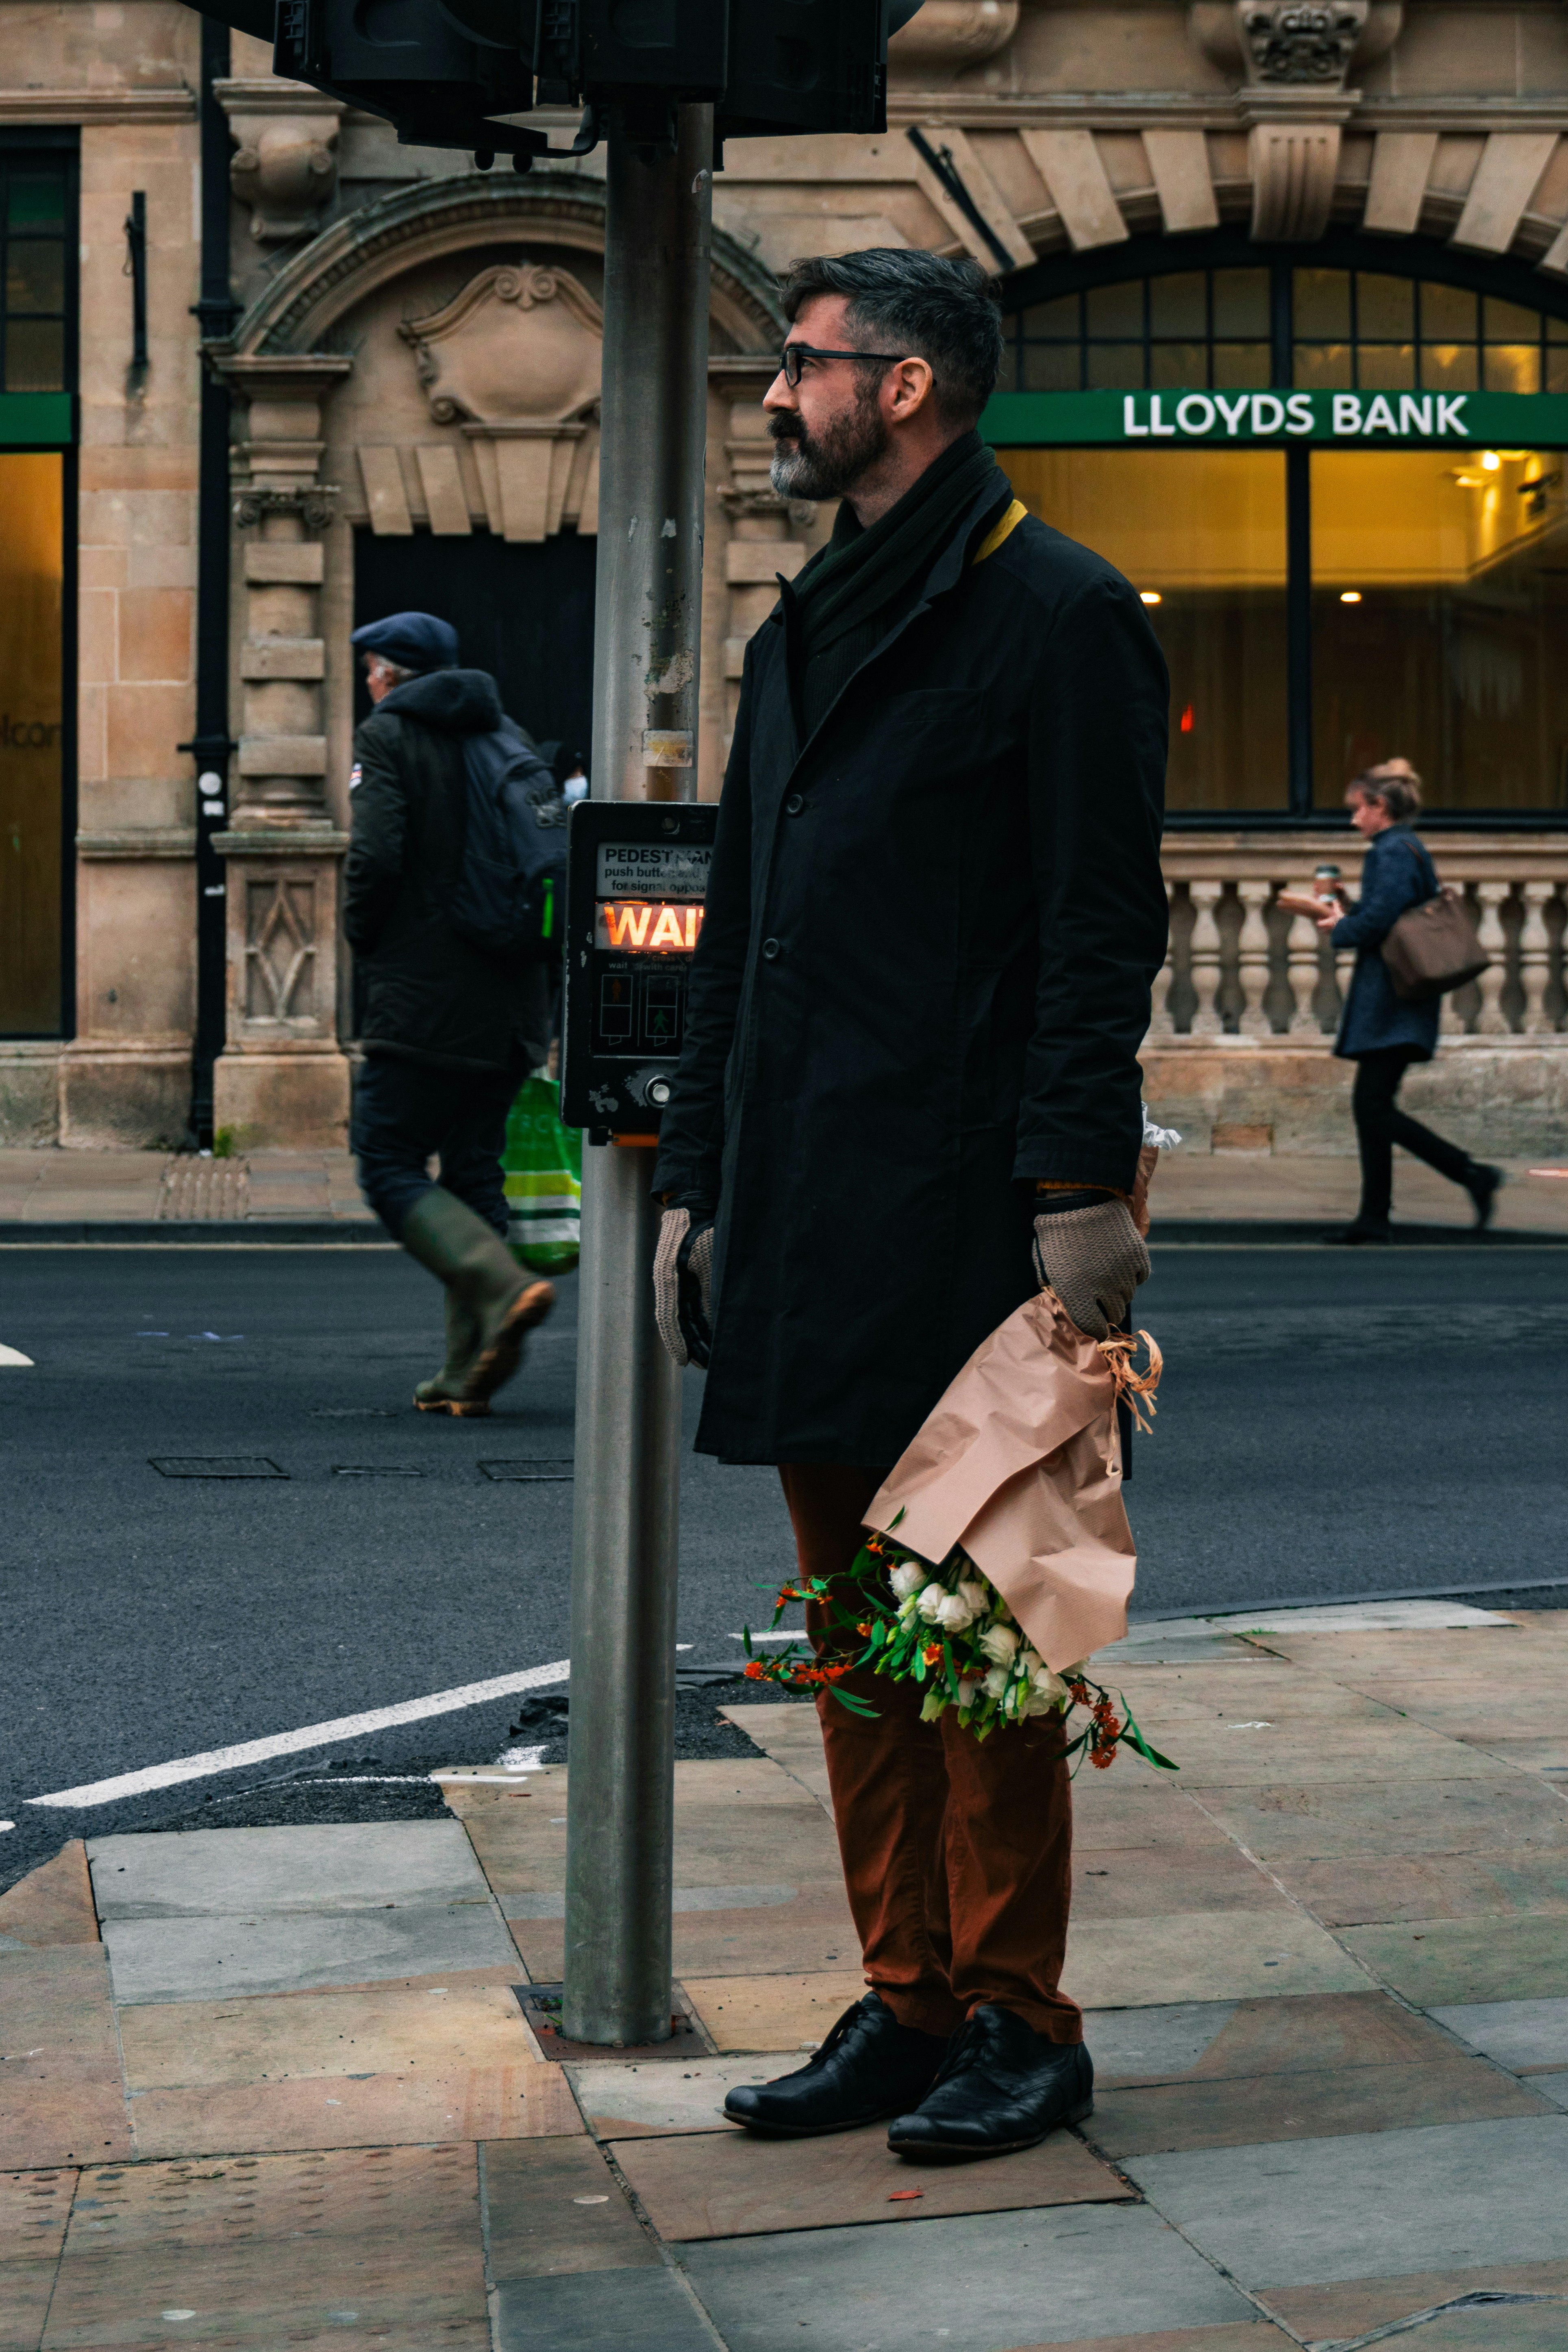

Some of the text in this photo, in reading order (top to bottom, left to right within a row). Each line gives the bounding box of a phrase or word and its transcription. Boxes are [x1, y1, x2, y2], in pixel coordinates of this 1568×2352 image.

[1124, 393, 1469, 436] LLOYDS BANK
[605, 848, 711, 865] PEDESTAN
[605, 867, 633, 878] push
[611, 880, 627, 891] for
